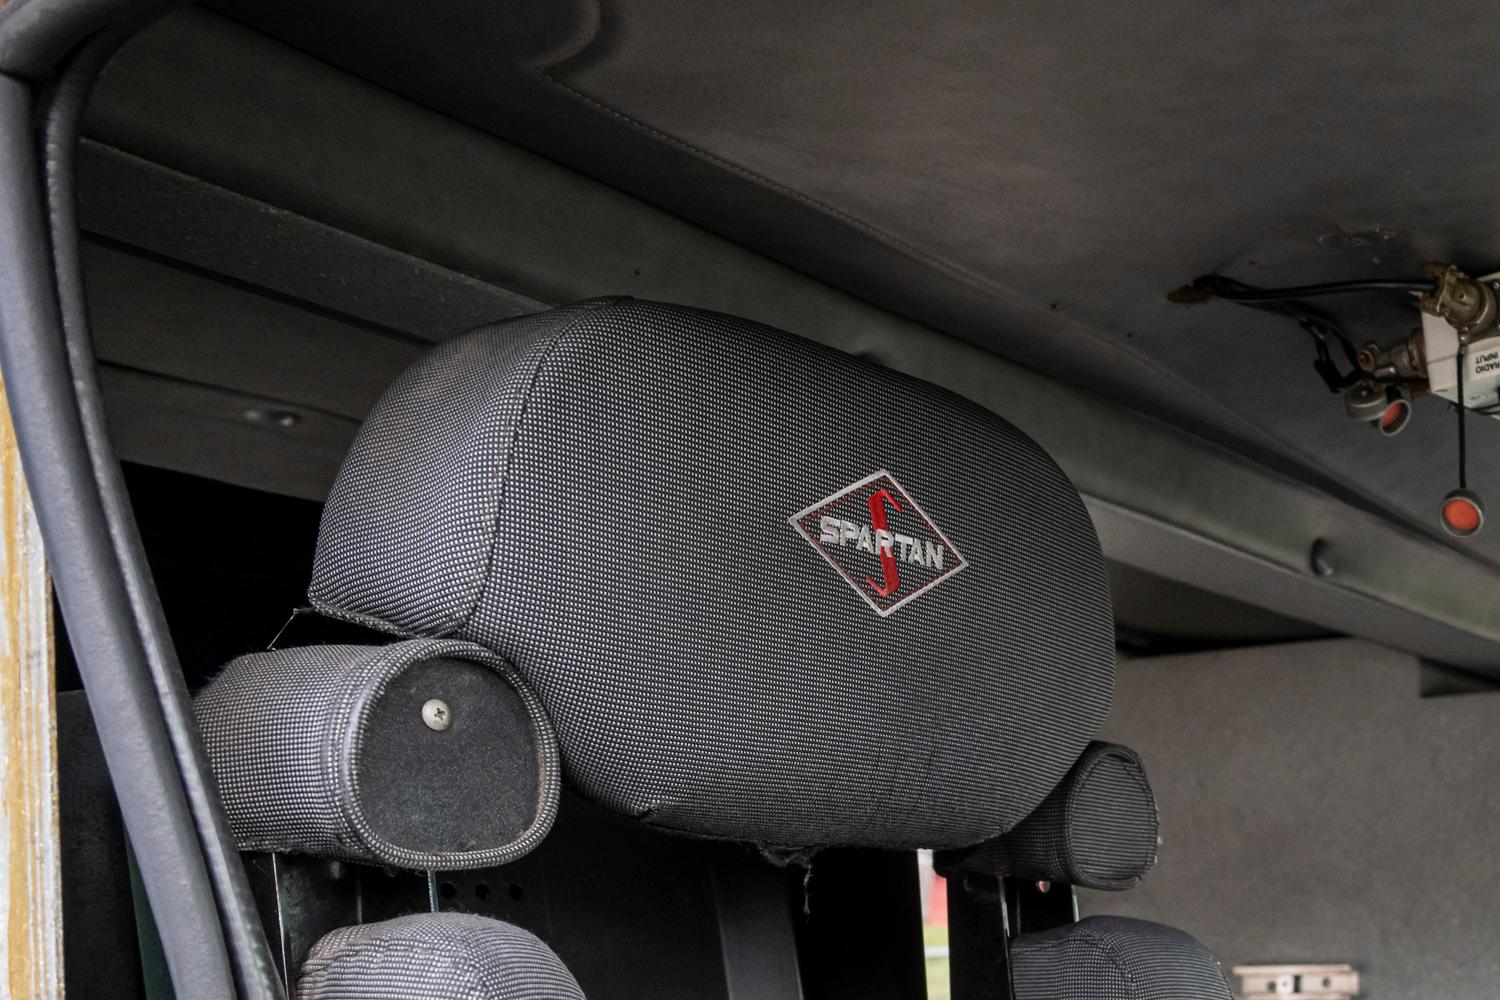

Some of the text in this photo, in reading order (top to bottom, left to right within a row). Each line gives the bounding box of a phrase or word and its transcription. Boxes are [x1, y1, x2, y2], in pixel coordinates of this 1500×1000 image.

[1475, 351, 1499, 364] INPUT
[1475, 361, 1500, 374] RADIO
[820, 515, 945, 571] SPARTAN
